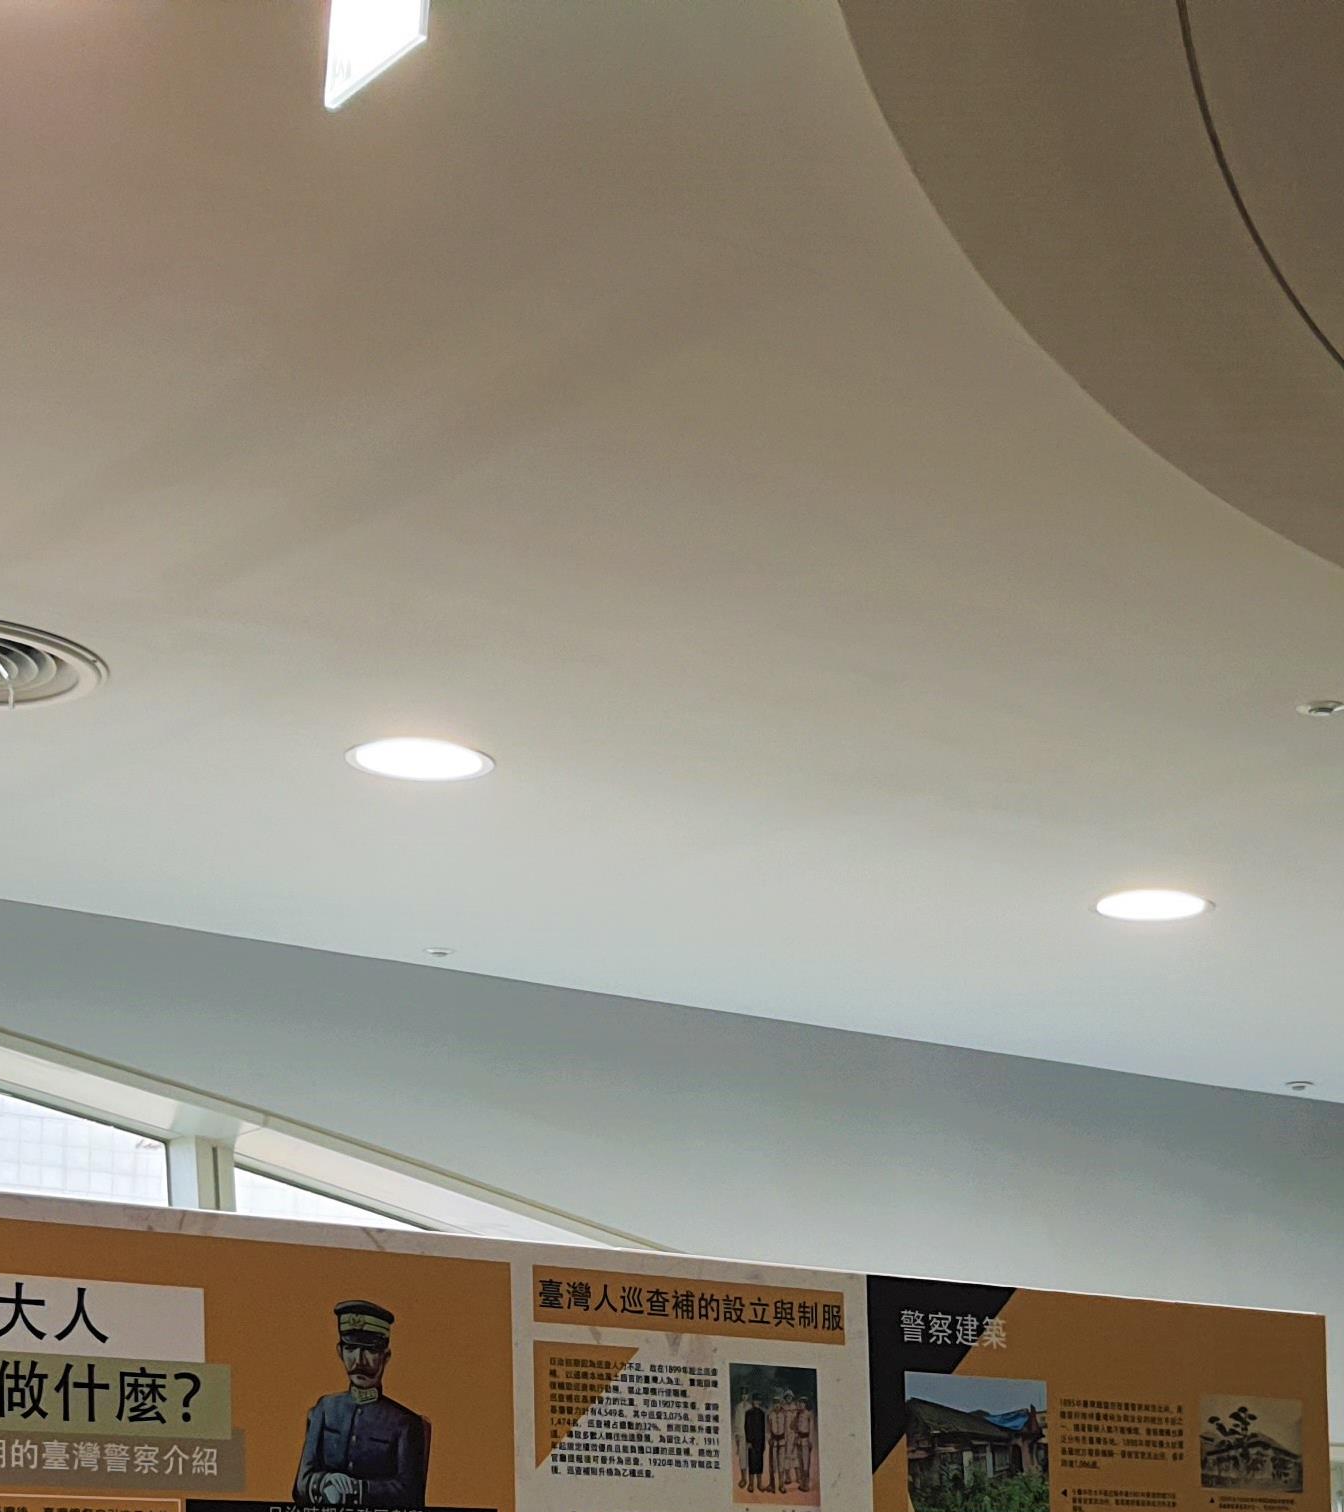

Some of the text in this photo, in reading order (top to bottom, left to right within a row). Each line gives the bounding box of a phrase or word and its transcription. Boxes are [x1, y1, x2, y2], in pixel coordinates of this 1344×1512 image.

[538, 1279, 844, 1331] 臺灣人巡查補的設立與制服
[900, 1310, 1007, 1349] 警察建築
